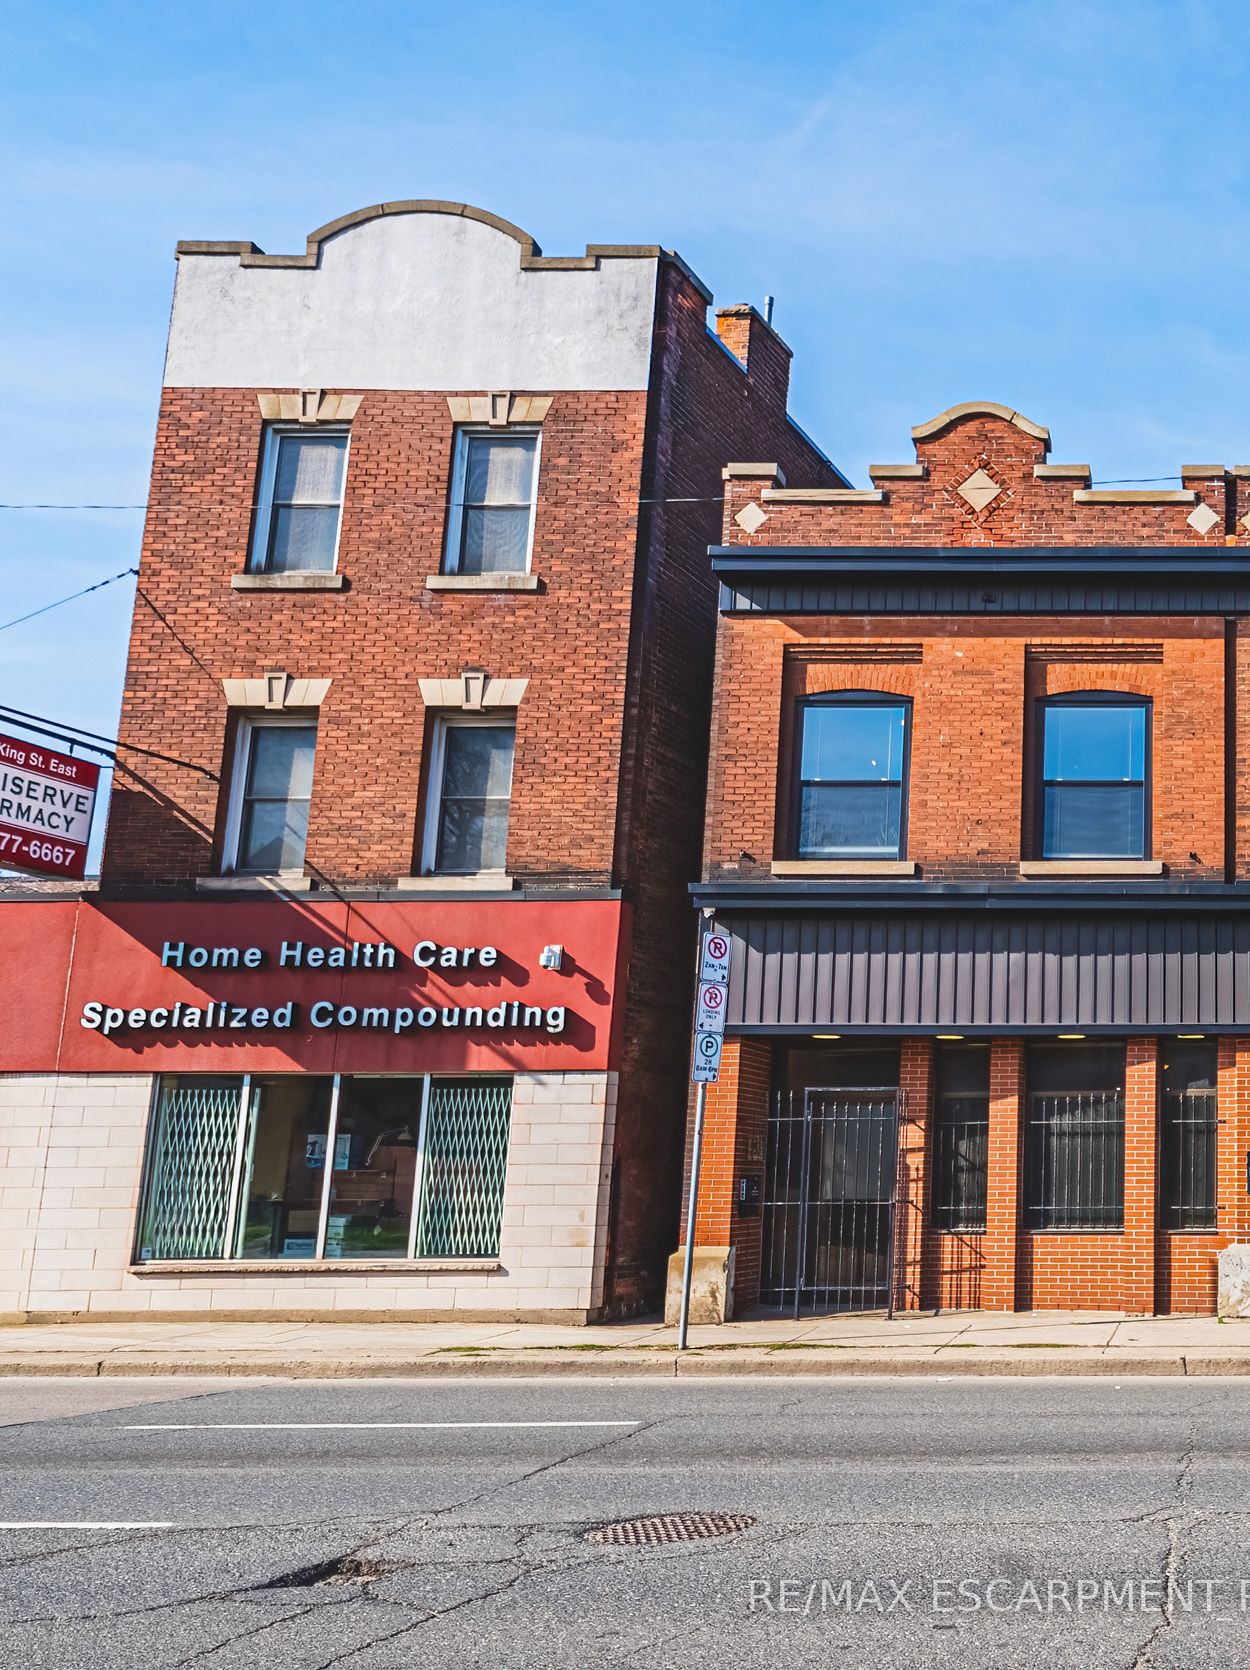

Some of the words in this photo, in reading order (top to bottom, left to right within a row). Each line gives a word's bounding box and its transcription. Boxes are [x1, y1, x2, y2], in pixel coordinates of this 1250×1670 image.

[29, 752, 45, 769] St.
[50, 758, 78, 778] East
[1, 773, 90, 814] ISERVE
[0, 797, 76, 833] RMACY
[161, 941, 262, 968] Home
[279, 941, 396, 968] Health
[413, 940, 498, 968] Care
[80, 1001, 293, 1035] Specialized
[310, 1001, 566, 1034] Compounding
